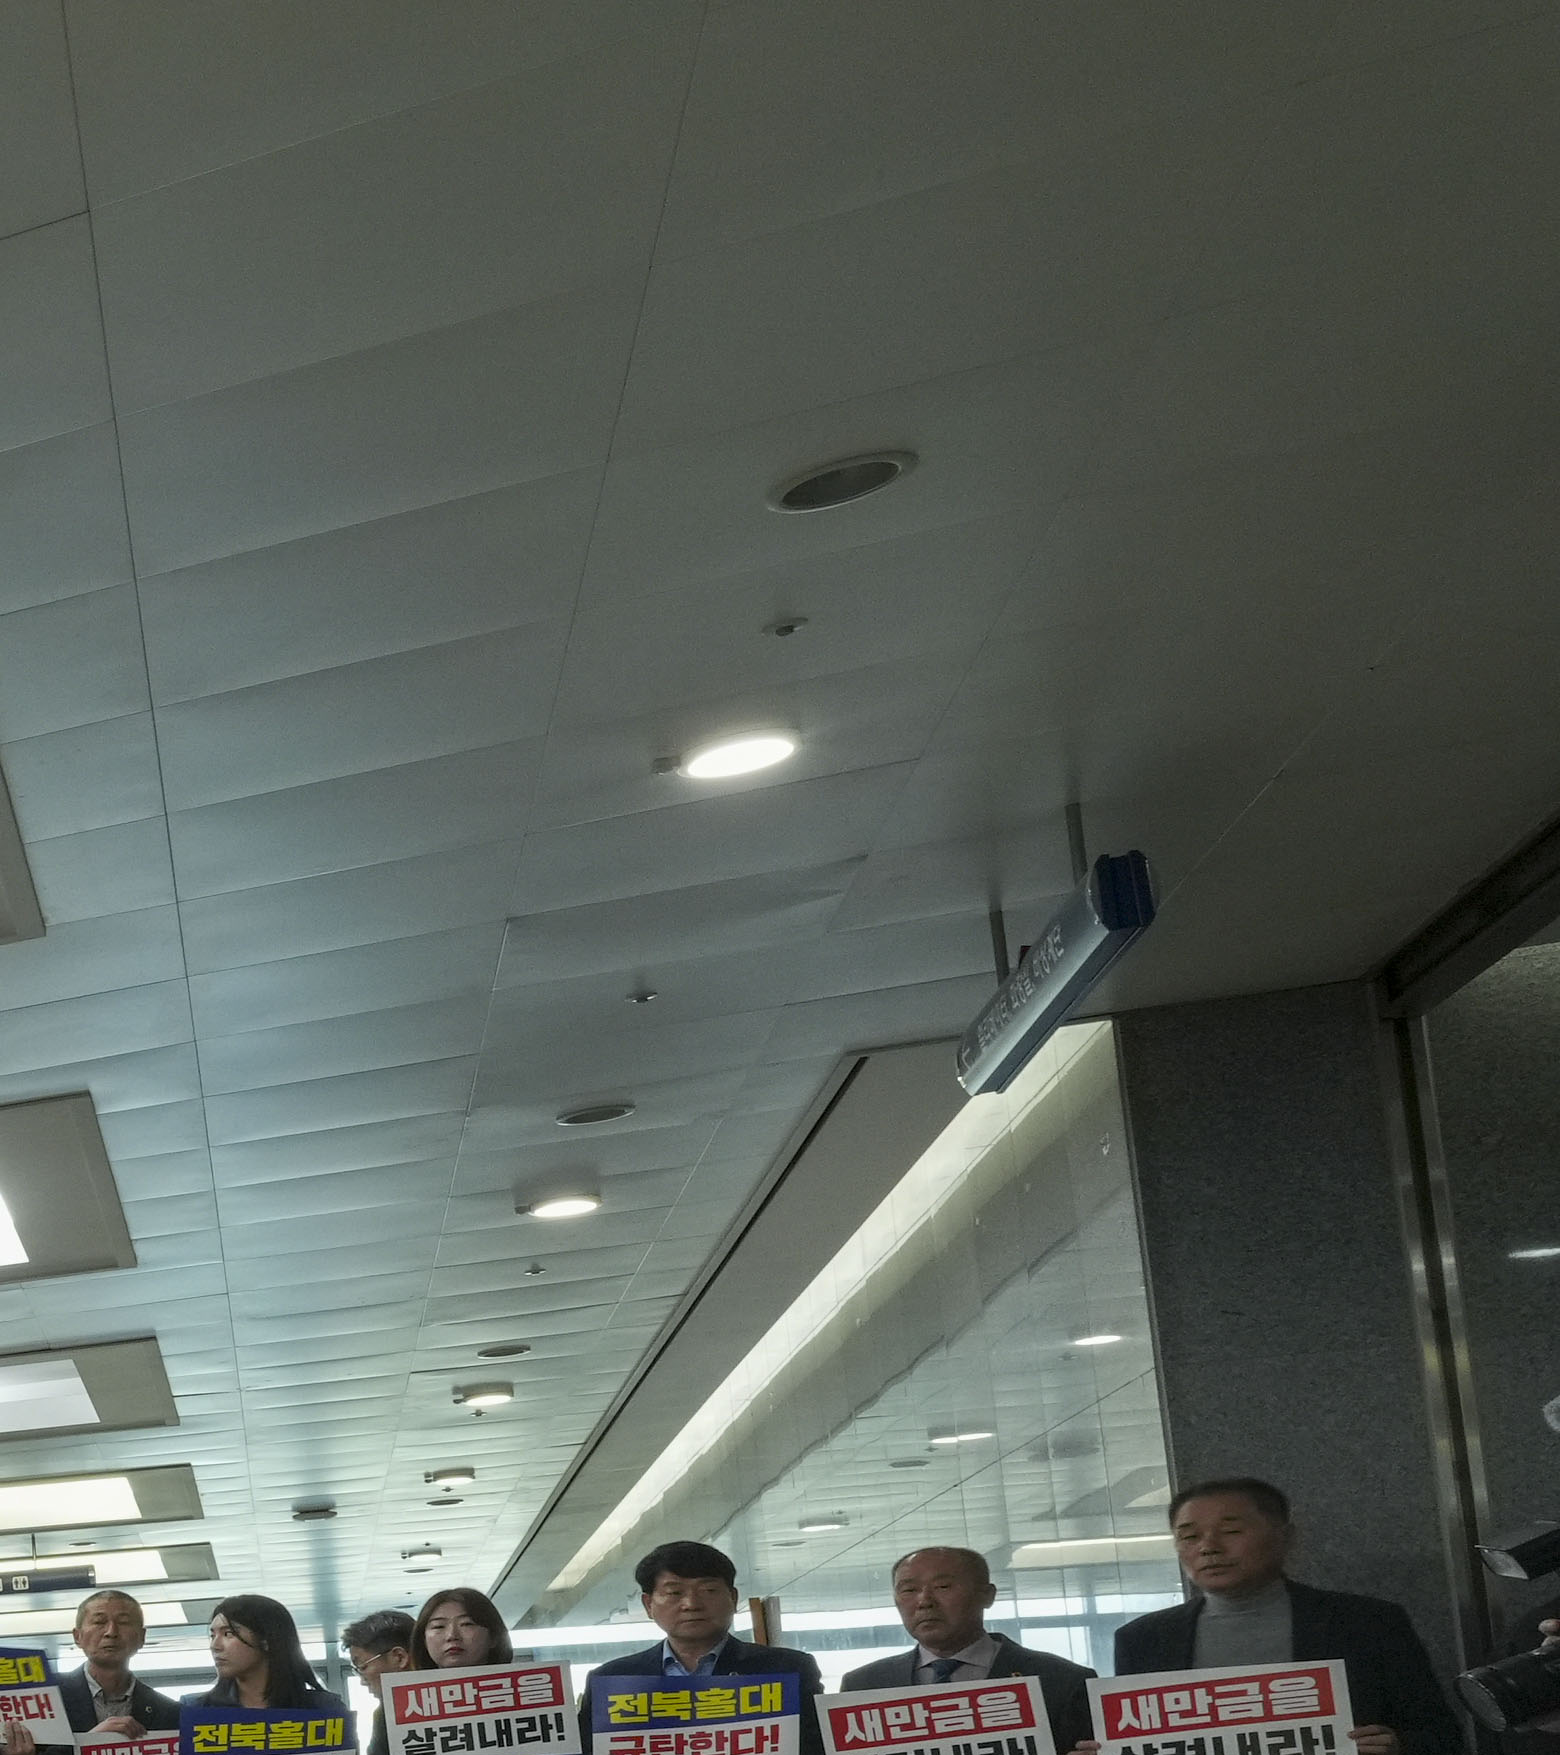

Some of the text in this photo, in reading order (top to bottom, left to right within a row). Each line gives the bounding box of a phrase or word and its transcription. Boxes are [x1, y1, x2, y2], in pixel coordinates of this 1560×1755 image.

[404, 1672, 553, 1719] 새만금을
[607, 1682, 783, 1724] 전북홀대
[844, 1689, 1024, 1744] 새만금을
[1116, 1675, 1320, 1735] 새만금을
[193, 1717, 344, 1753] 전북홀대
